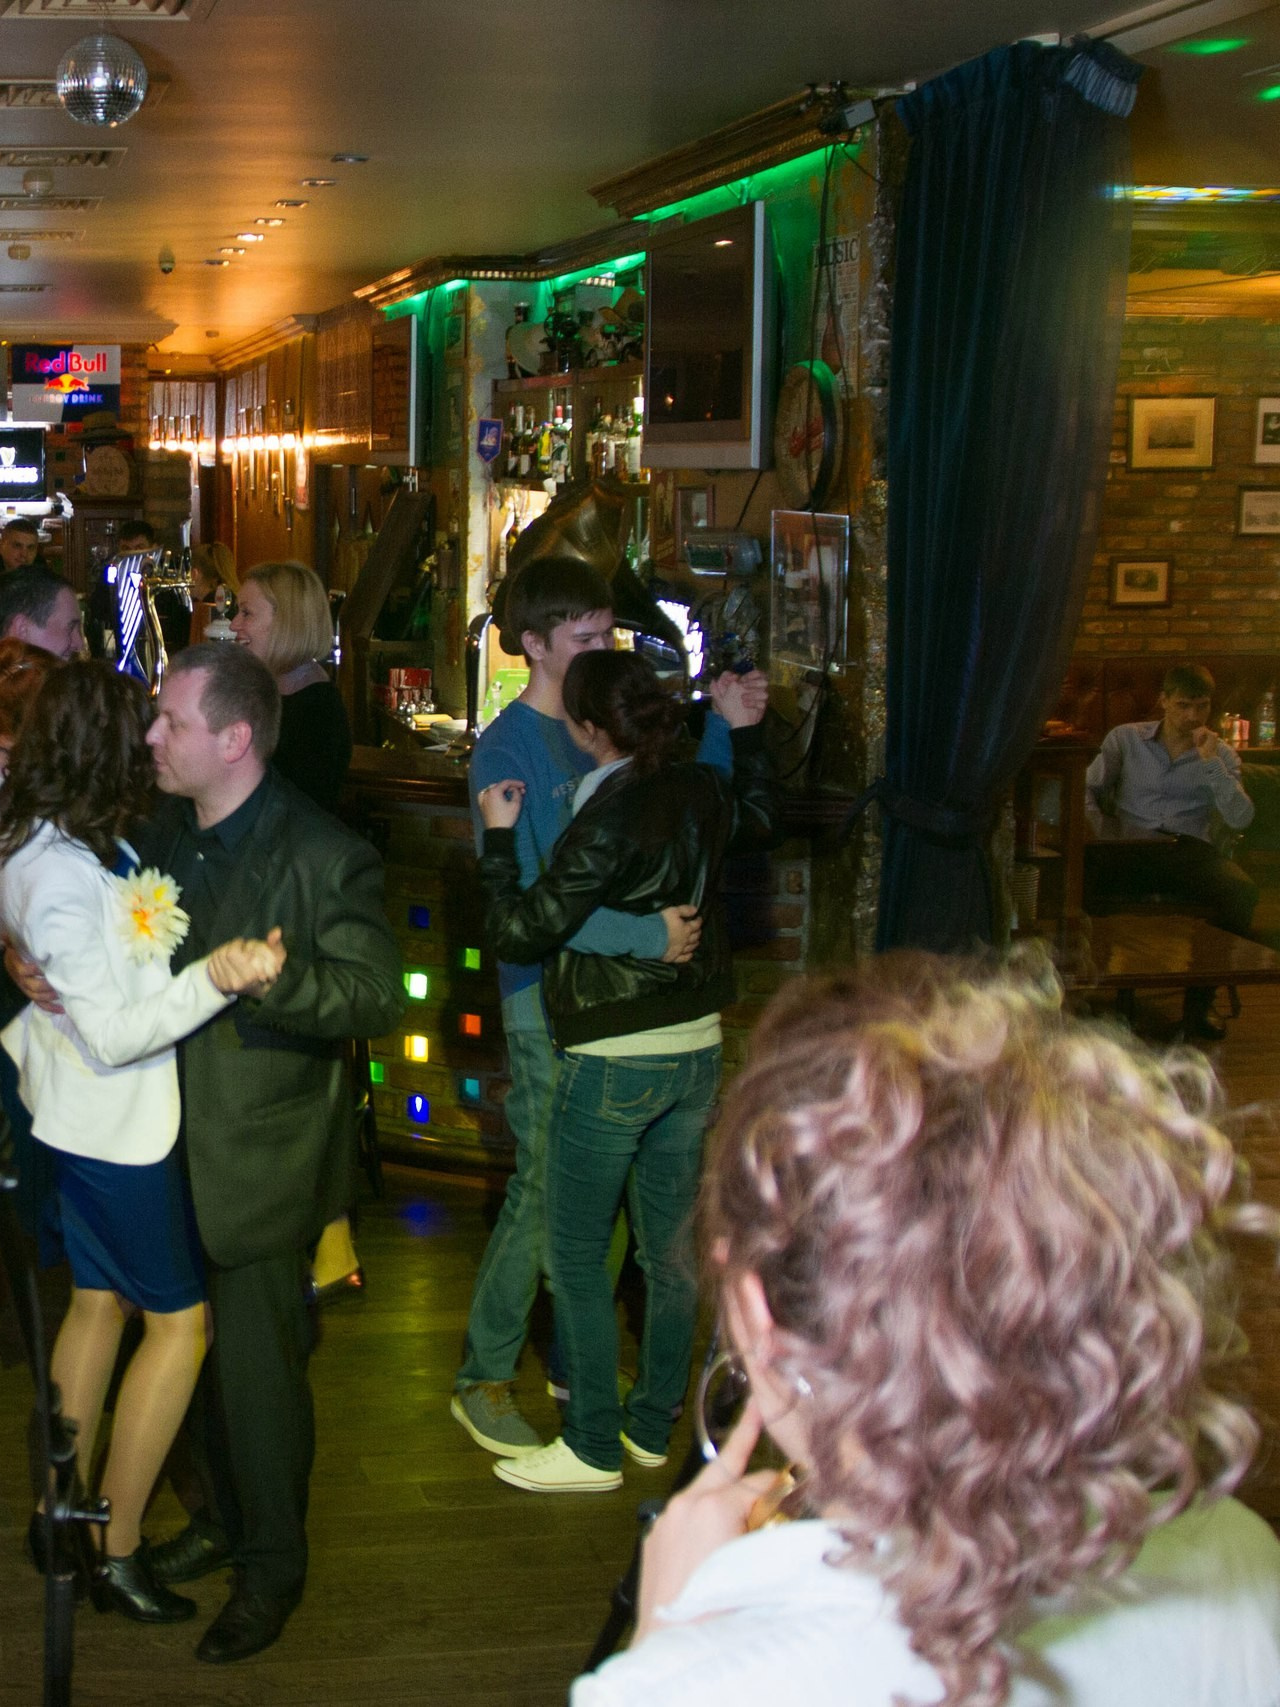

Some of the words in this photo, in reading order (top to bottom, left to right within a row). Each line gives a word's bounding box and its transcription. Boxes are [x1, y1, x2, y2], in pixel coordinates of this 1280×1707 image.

[25, 351, 66, 373] Red
[68, 352, 107, 372] Bull
[71, 393, 104, 404] DRINK
